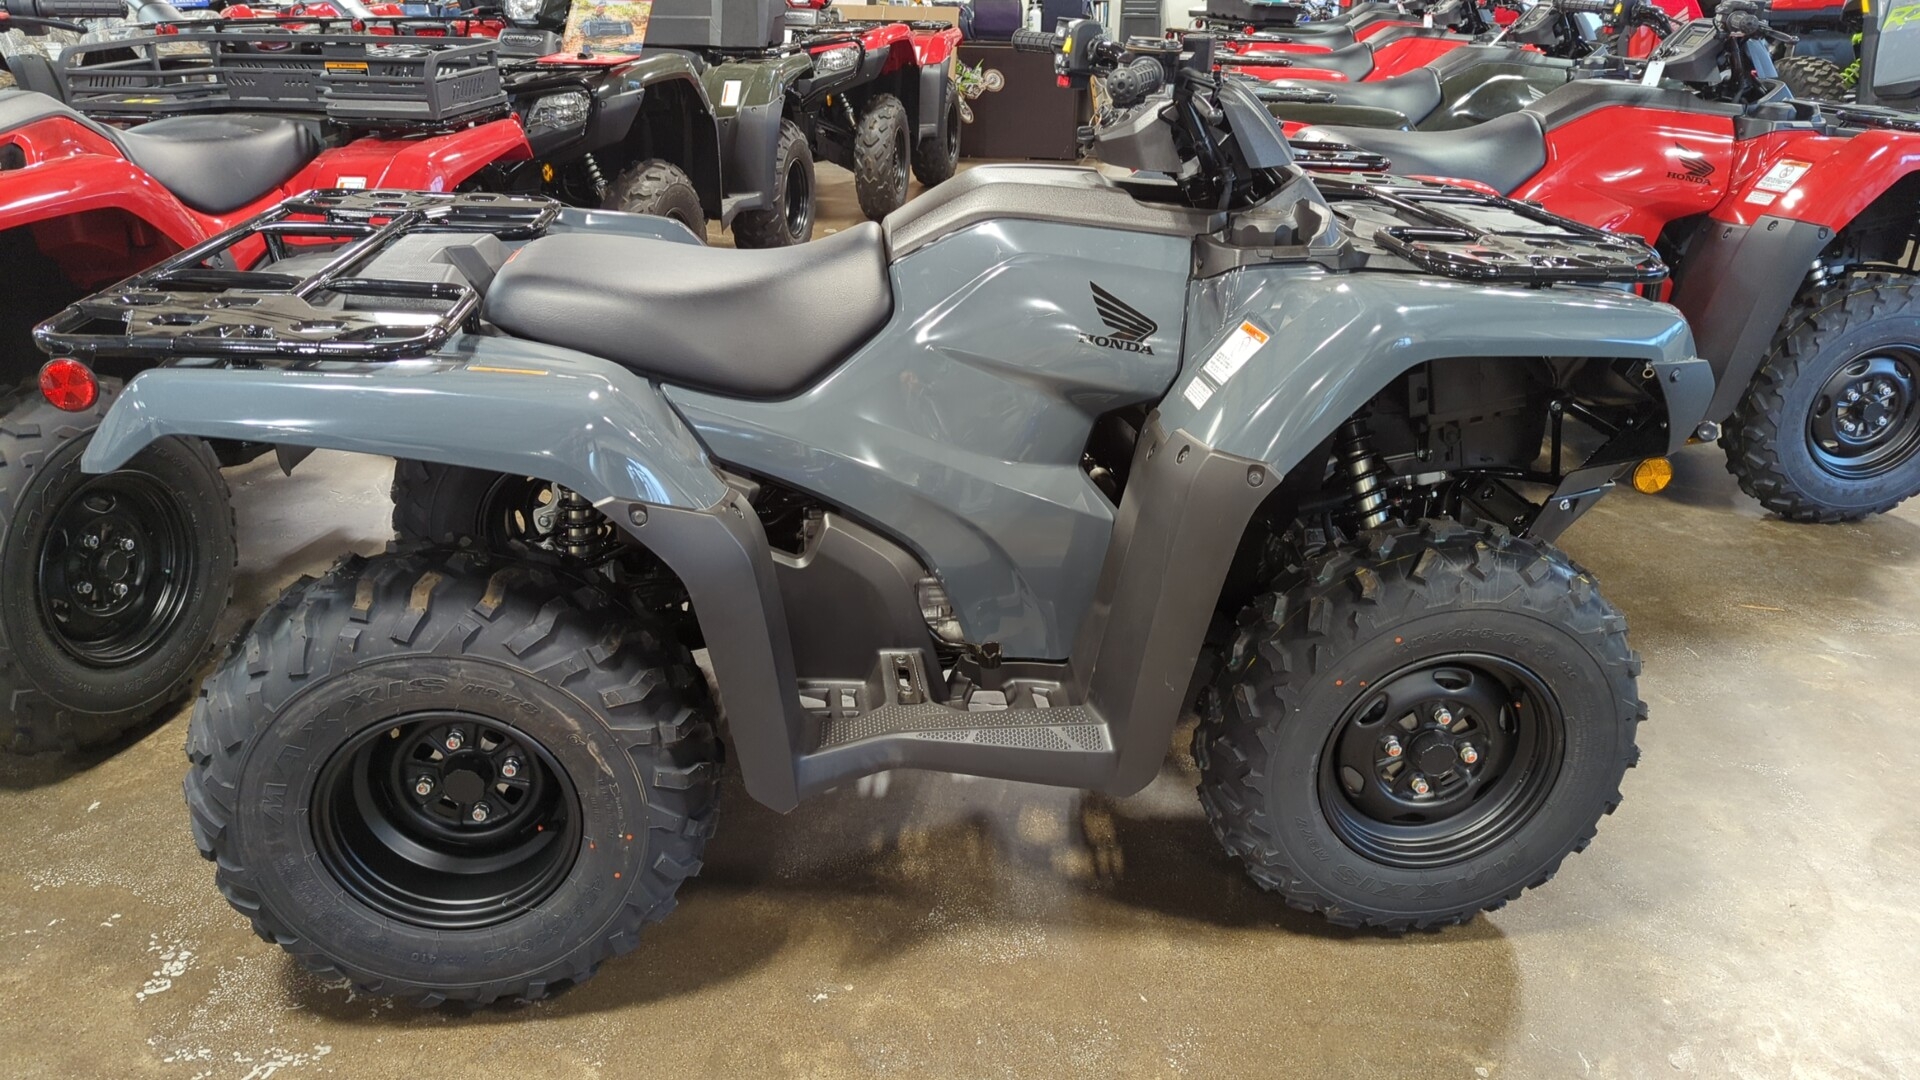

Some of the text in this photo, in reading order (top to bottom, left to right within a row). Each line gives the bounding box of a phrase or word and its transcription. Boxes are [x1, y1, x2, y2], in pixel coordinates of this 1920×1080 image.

[502, 34, 544, 42] FOREMAN
[1666, 171, 1712, 186] HONDA
[1078, 332, 1155, 356] HONDA
[262, 677, 448, 825] MAXXIS
[1330, 850, 1524, 901] MAXXIS
